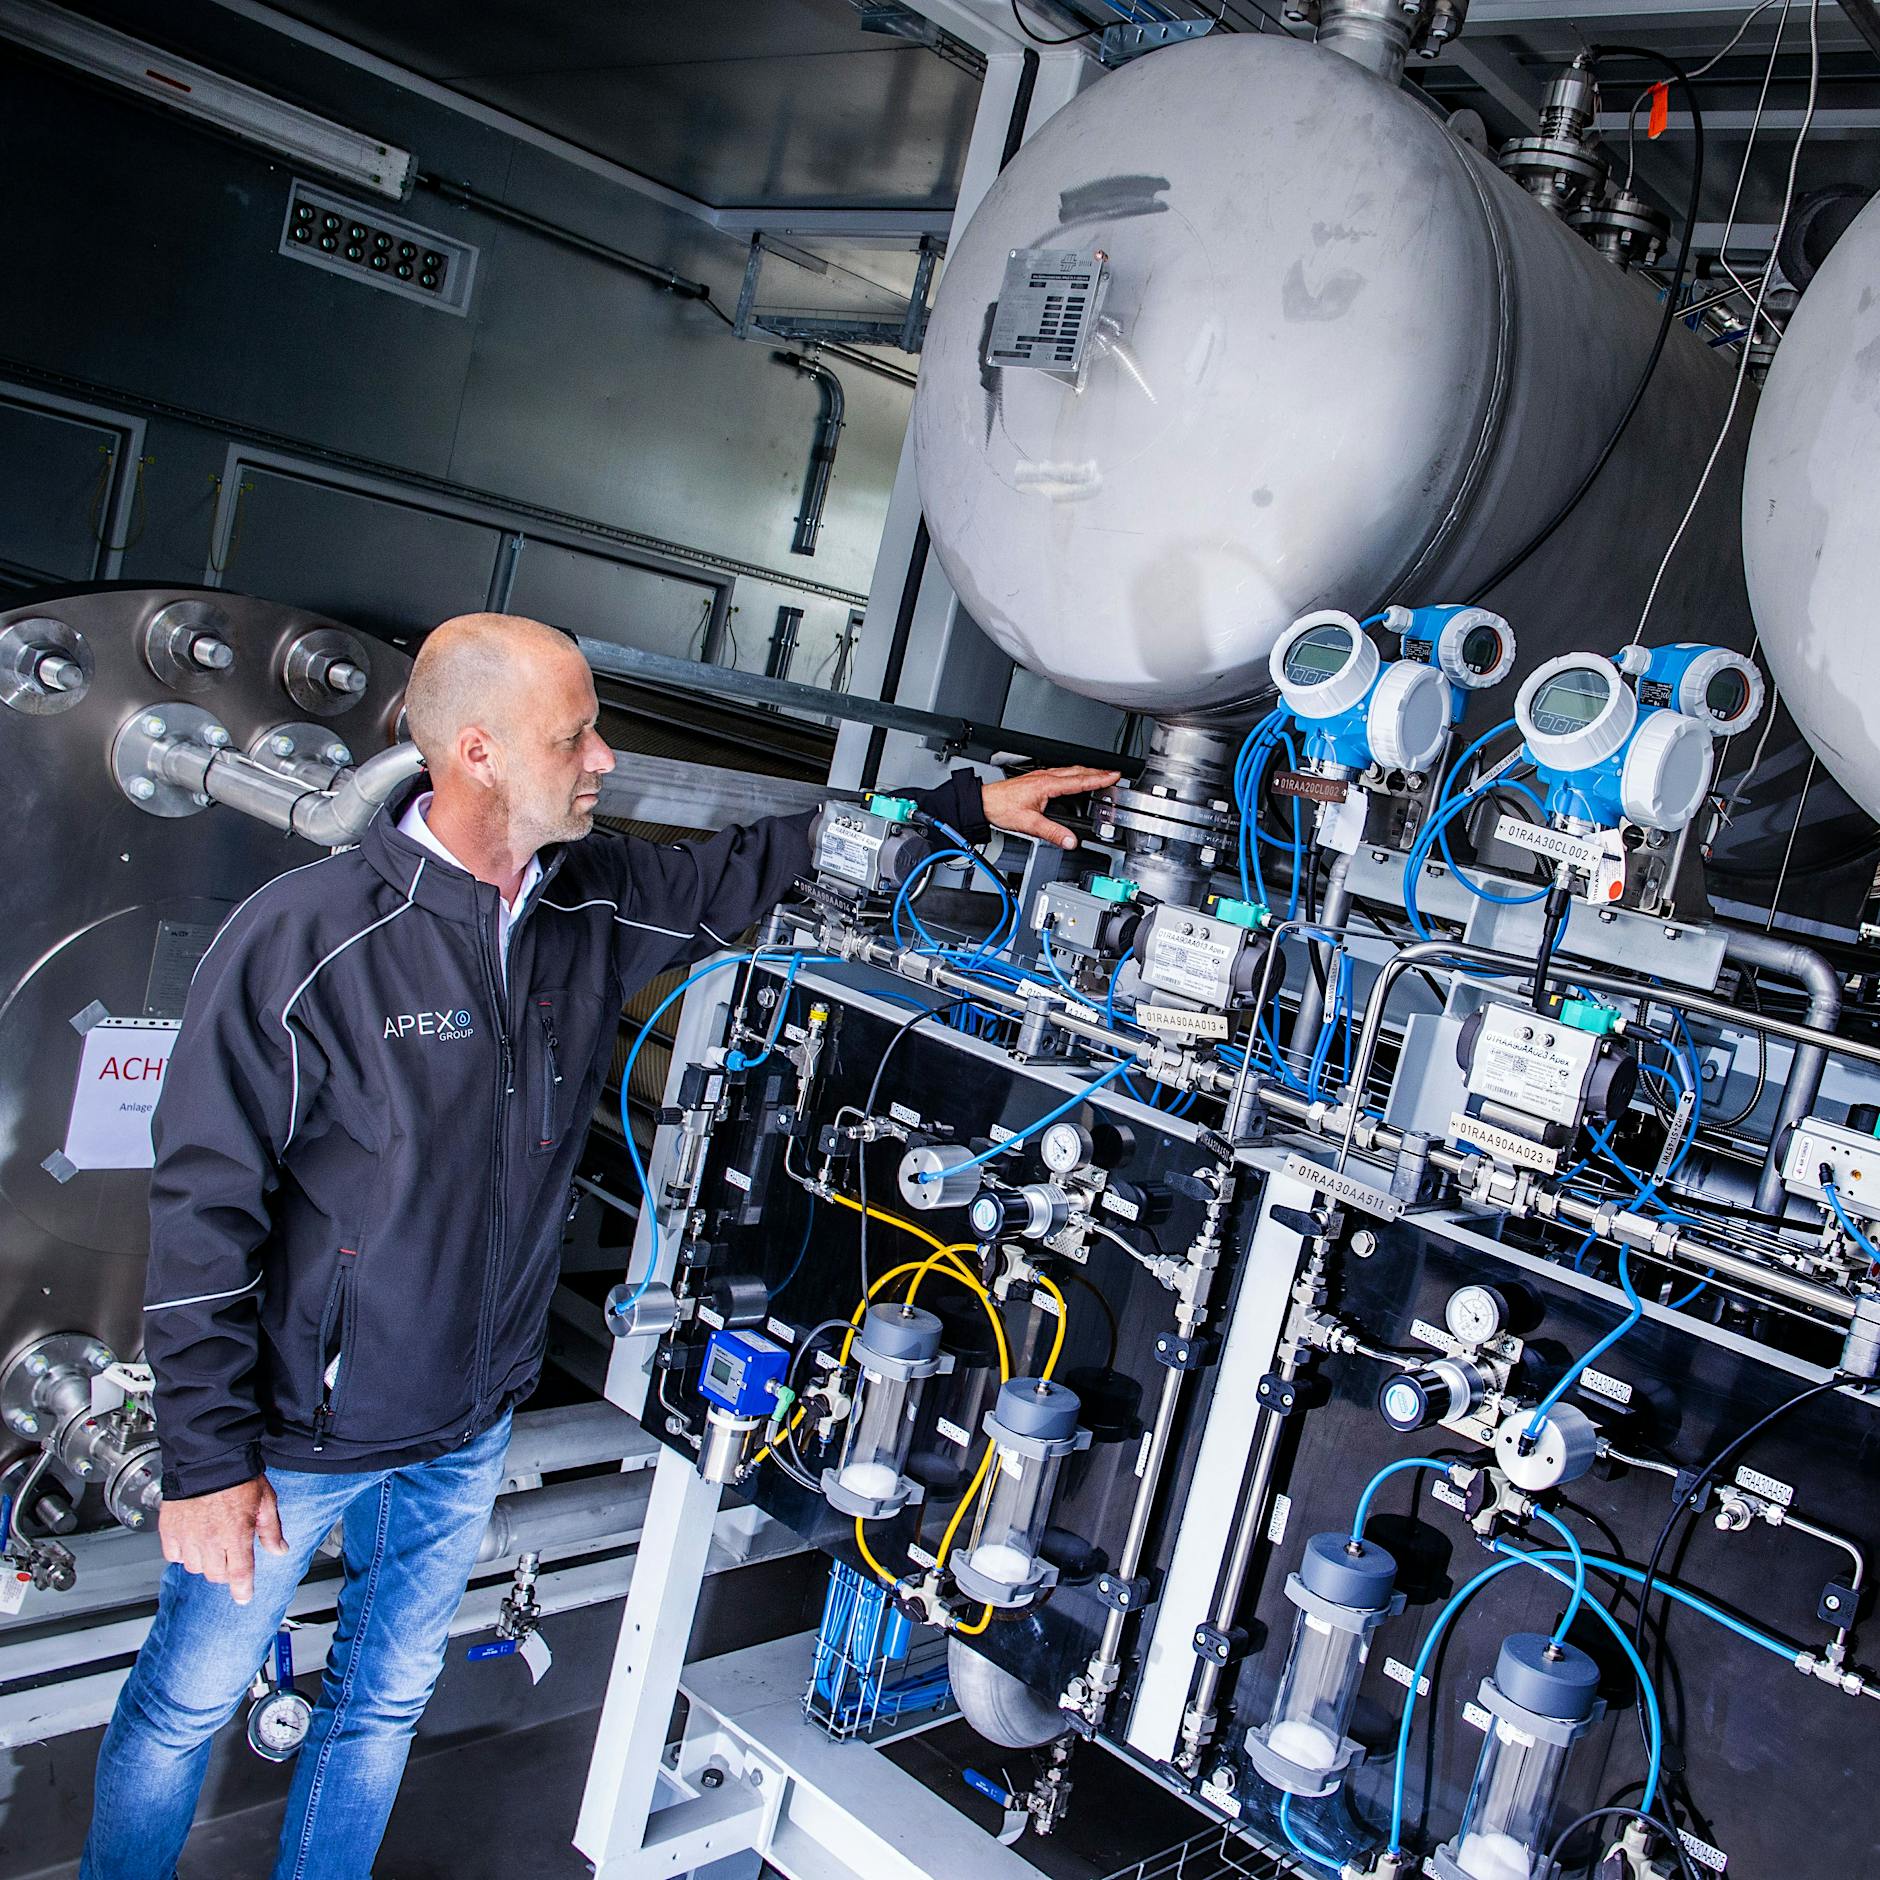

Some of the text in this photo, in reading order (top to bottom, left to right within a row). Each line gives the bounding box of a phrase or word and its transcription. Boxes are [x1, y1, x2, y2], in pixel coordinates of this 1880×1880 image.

[1280, 778, 1340, 798] 01RAA20CL002
[1507, 825, 1590, 862] 01RAA30CL002
[800, 882, 851, 912] 01RAA90AA014
[384, 1010, 456, 1039] APEX
[439, 1028, 474, 1041] GROUP
[1146, 1012, 1217, 1031] 01RAA90AA013
[98, 1056, 170, 1081] ACH
[1549, 1053, 1569, 1067] Apex
[119, 1102, 153, 1113] Anlage
[1460, 1123, 1544, 1164] 01RAA90AA023
[1298, 1165, 1385, 1210] 01RAA30AA511
[1581, 1370, 1631, 1402] 01RAA30AA502
[1737, 1468, 1792, 1503] 01RAA30AA504
